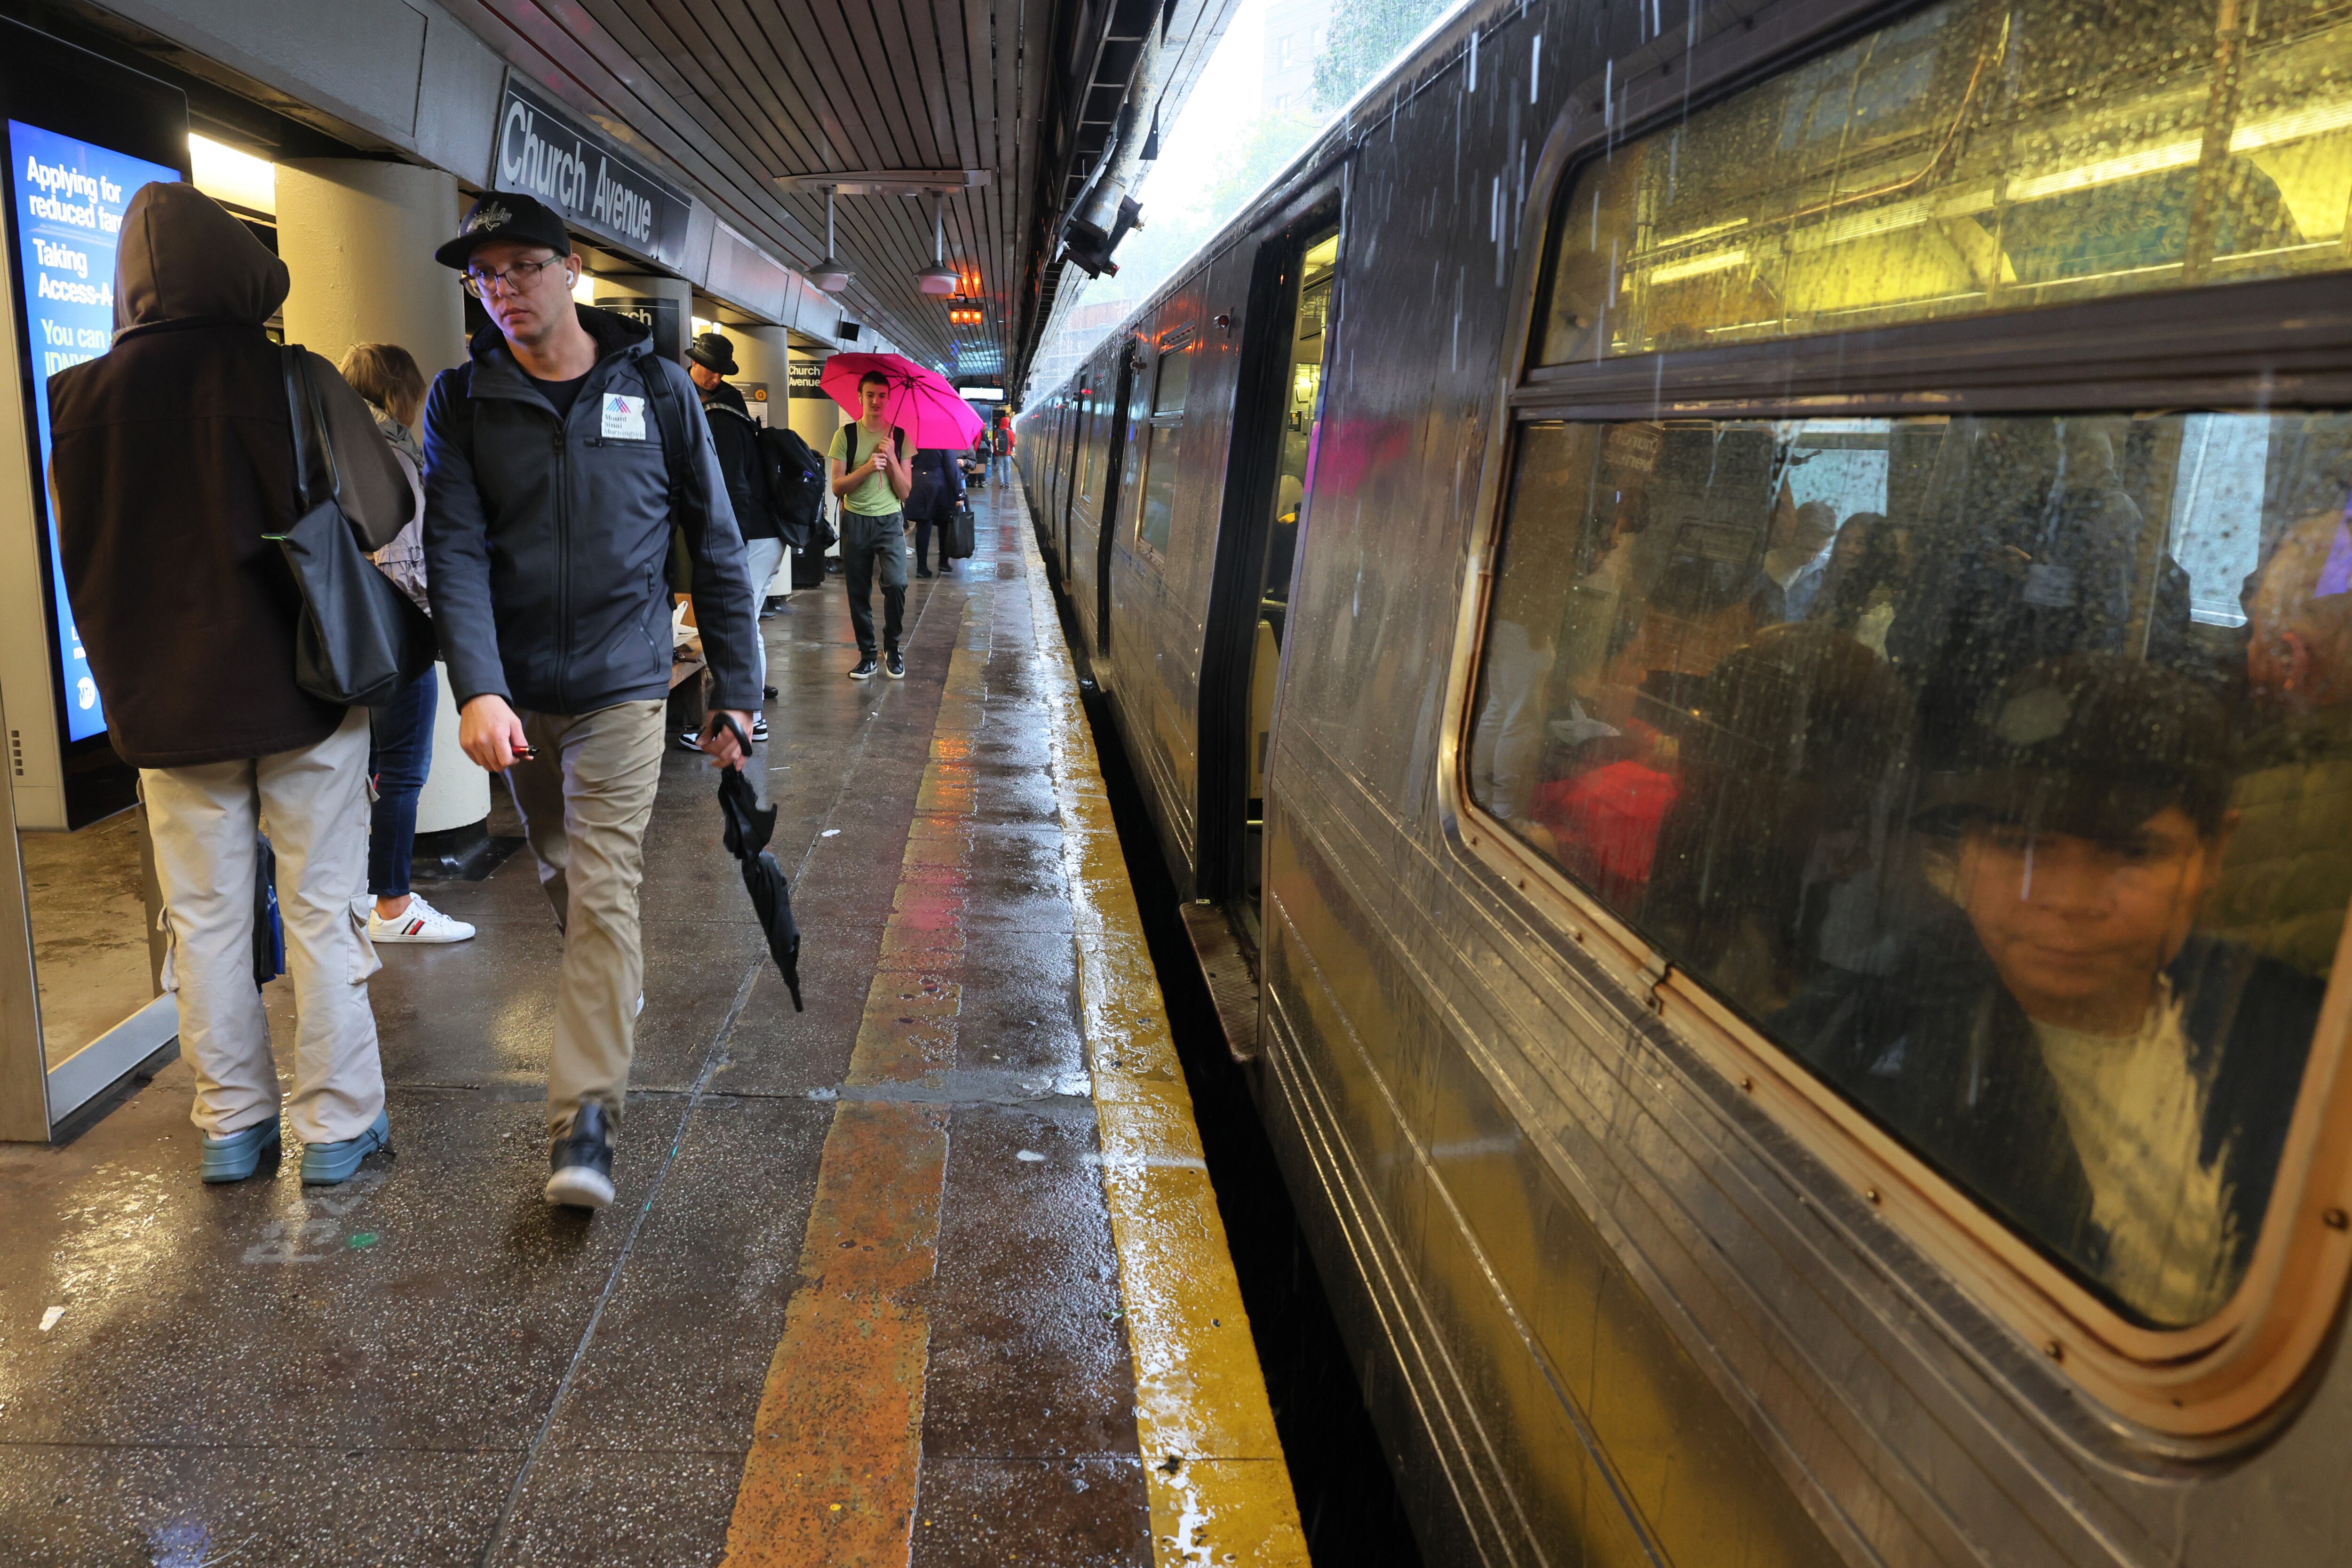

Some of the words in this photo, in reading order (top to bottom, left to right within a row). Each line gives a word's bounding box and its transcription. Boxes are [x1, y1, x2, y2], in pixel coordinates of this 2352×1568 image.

[27, 156, 98, 204] Applying
[100, 175, 122, 204] for
[502, 101, 586, 212] Church
[591, 156, 652, 243] Avenue
[29, 193, 96, 229] reduced
[32, 238, 88, 279] Taking
[40, 318, 73, 347] You
[77, 328, 106, 349] can
[789, 365, 820, 375] Church
[789, 376, 821, 387] Avenue
